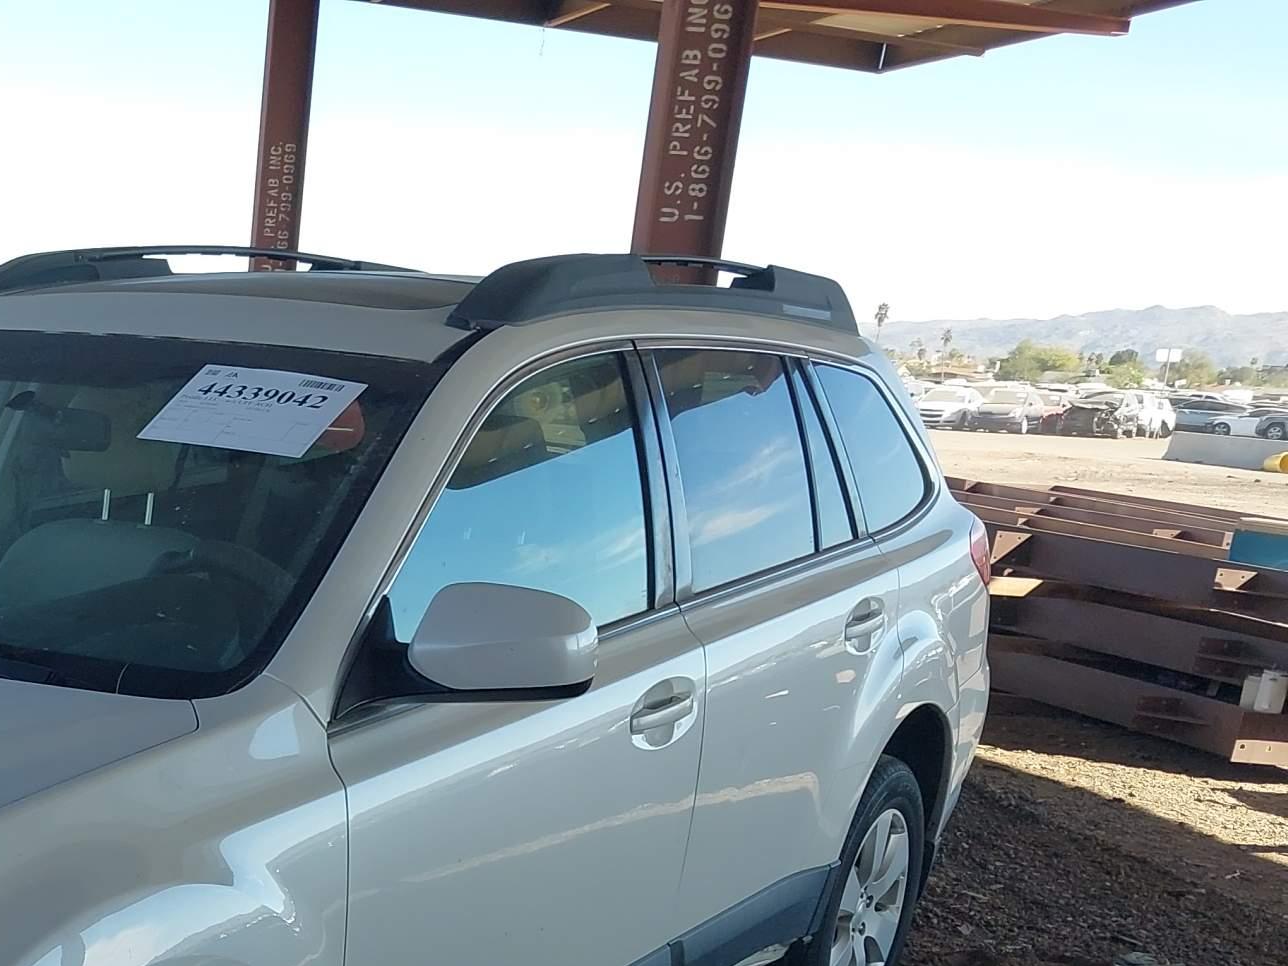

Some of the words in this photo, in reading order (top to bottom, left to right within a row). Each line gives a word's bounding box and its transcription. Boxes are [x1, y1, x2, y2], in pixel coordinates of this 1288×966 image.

[668, 48, 702, 156] PREFAB
[268, 141, 284, 170] INC.
[264, 177, 281, 237] PREFAB
[658, 173, 686, 223] U.S.
[197, 381, 329, 410] 44339042
